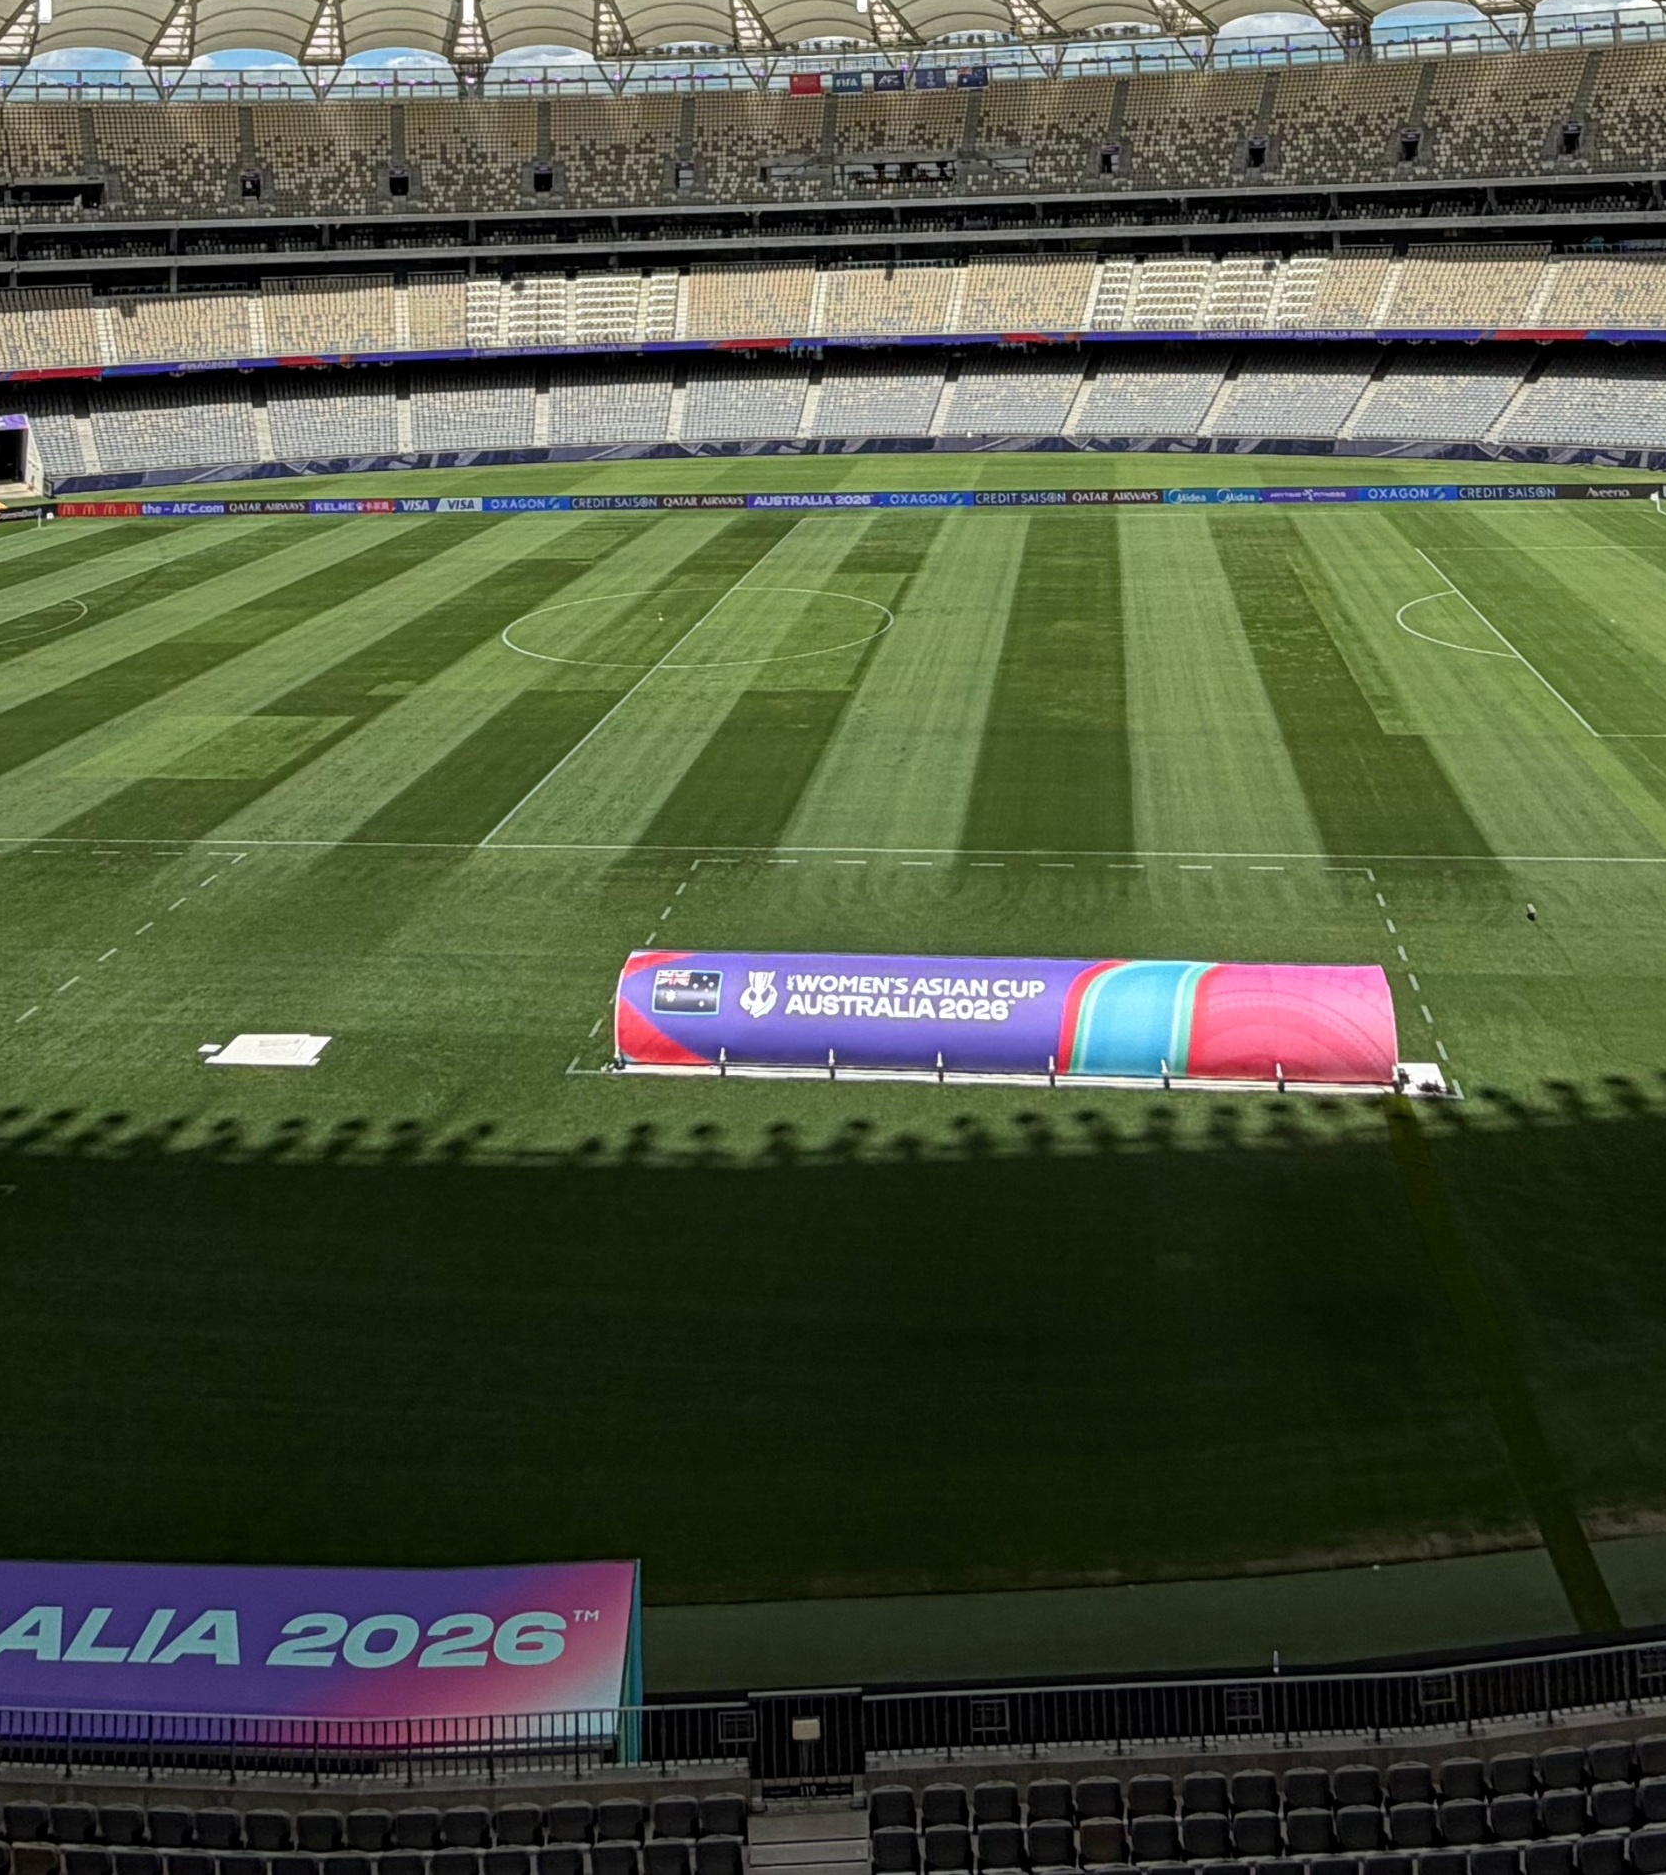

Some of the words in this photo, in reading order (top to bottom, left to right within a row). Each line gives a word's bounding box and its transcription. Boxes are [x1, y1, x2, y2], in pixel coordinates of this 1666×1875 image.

[889, 493, 948, 505] OXAGON
[975, 493, 1017, 505] CREDIT
[1072, 492, 1108, 503] QATAR
[1112, 491, 1159, 502] AIRWAYS
[1367, 487, 1429, 499] OXAGON
[1459, 487, 1504, 499] CREDIT
[230, 502, 261, 513] QATAR
[264, 501, 306, 512] AIRWAYS
[315, 502, 355, 511] KELME
[400, 499, 430, 511] VISA
[447, 499, 475, 510] VISA
[490, 498, 546, 510] OXAGON
[572, 498, 612, 509] CREDIT
[663, 496, 698, 507] QATAR
[700, 495, 745, 507] AIRWAYS
[754, 495, 832, 507] AUSTRALIA
[795, 973, 909, 994] WOMEN'S
[912, 975, 990, 998] ASIAN
[994, 978, 1046, 999] CUP
[784, 995, 935, 1019] AUSTRALIA
[938, 998, 1011, 1022] 2026
[267, 1612, 568, 1669] 2026
